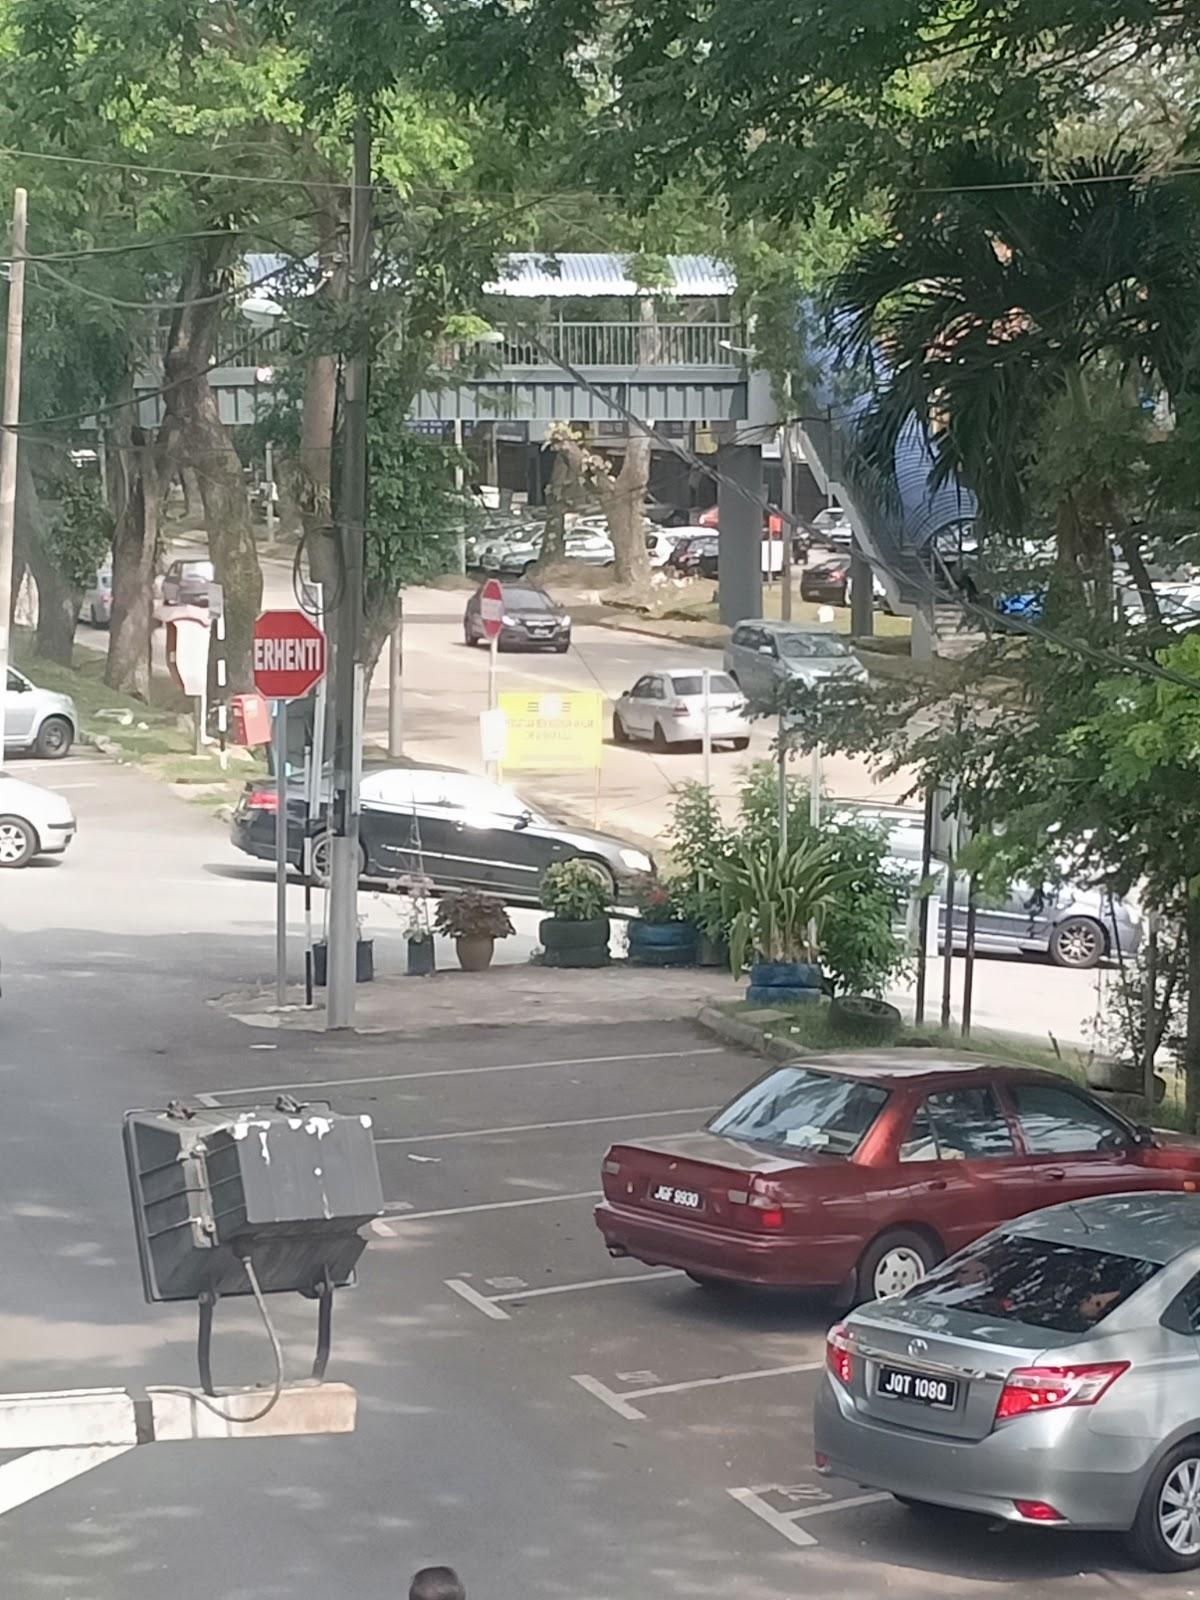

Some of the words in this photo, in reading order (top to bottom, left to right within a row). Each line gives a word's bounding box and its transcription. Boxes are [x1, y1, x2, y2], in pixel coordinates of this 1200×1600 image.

[254, 638, 321, 671] ERHENTI
[885, 1372, 912, 1395] JQT
[914, 1377, 947, 1401] 1080
